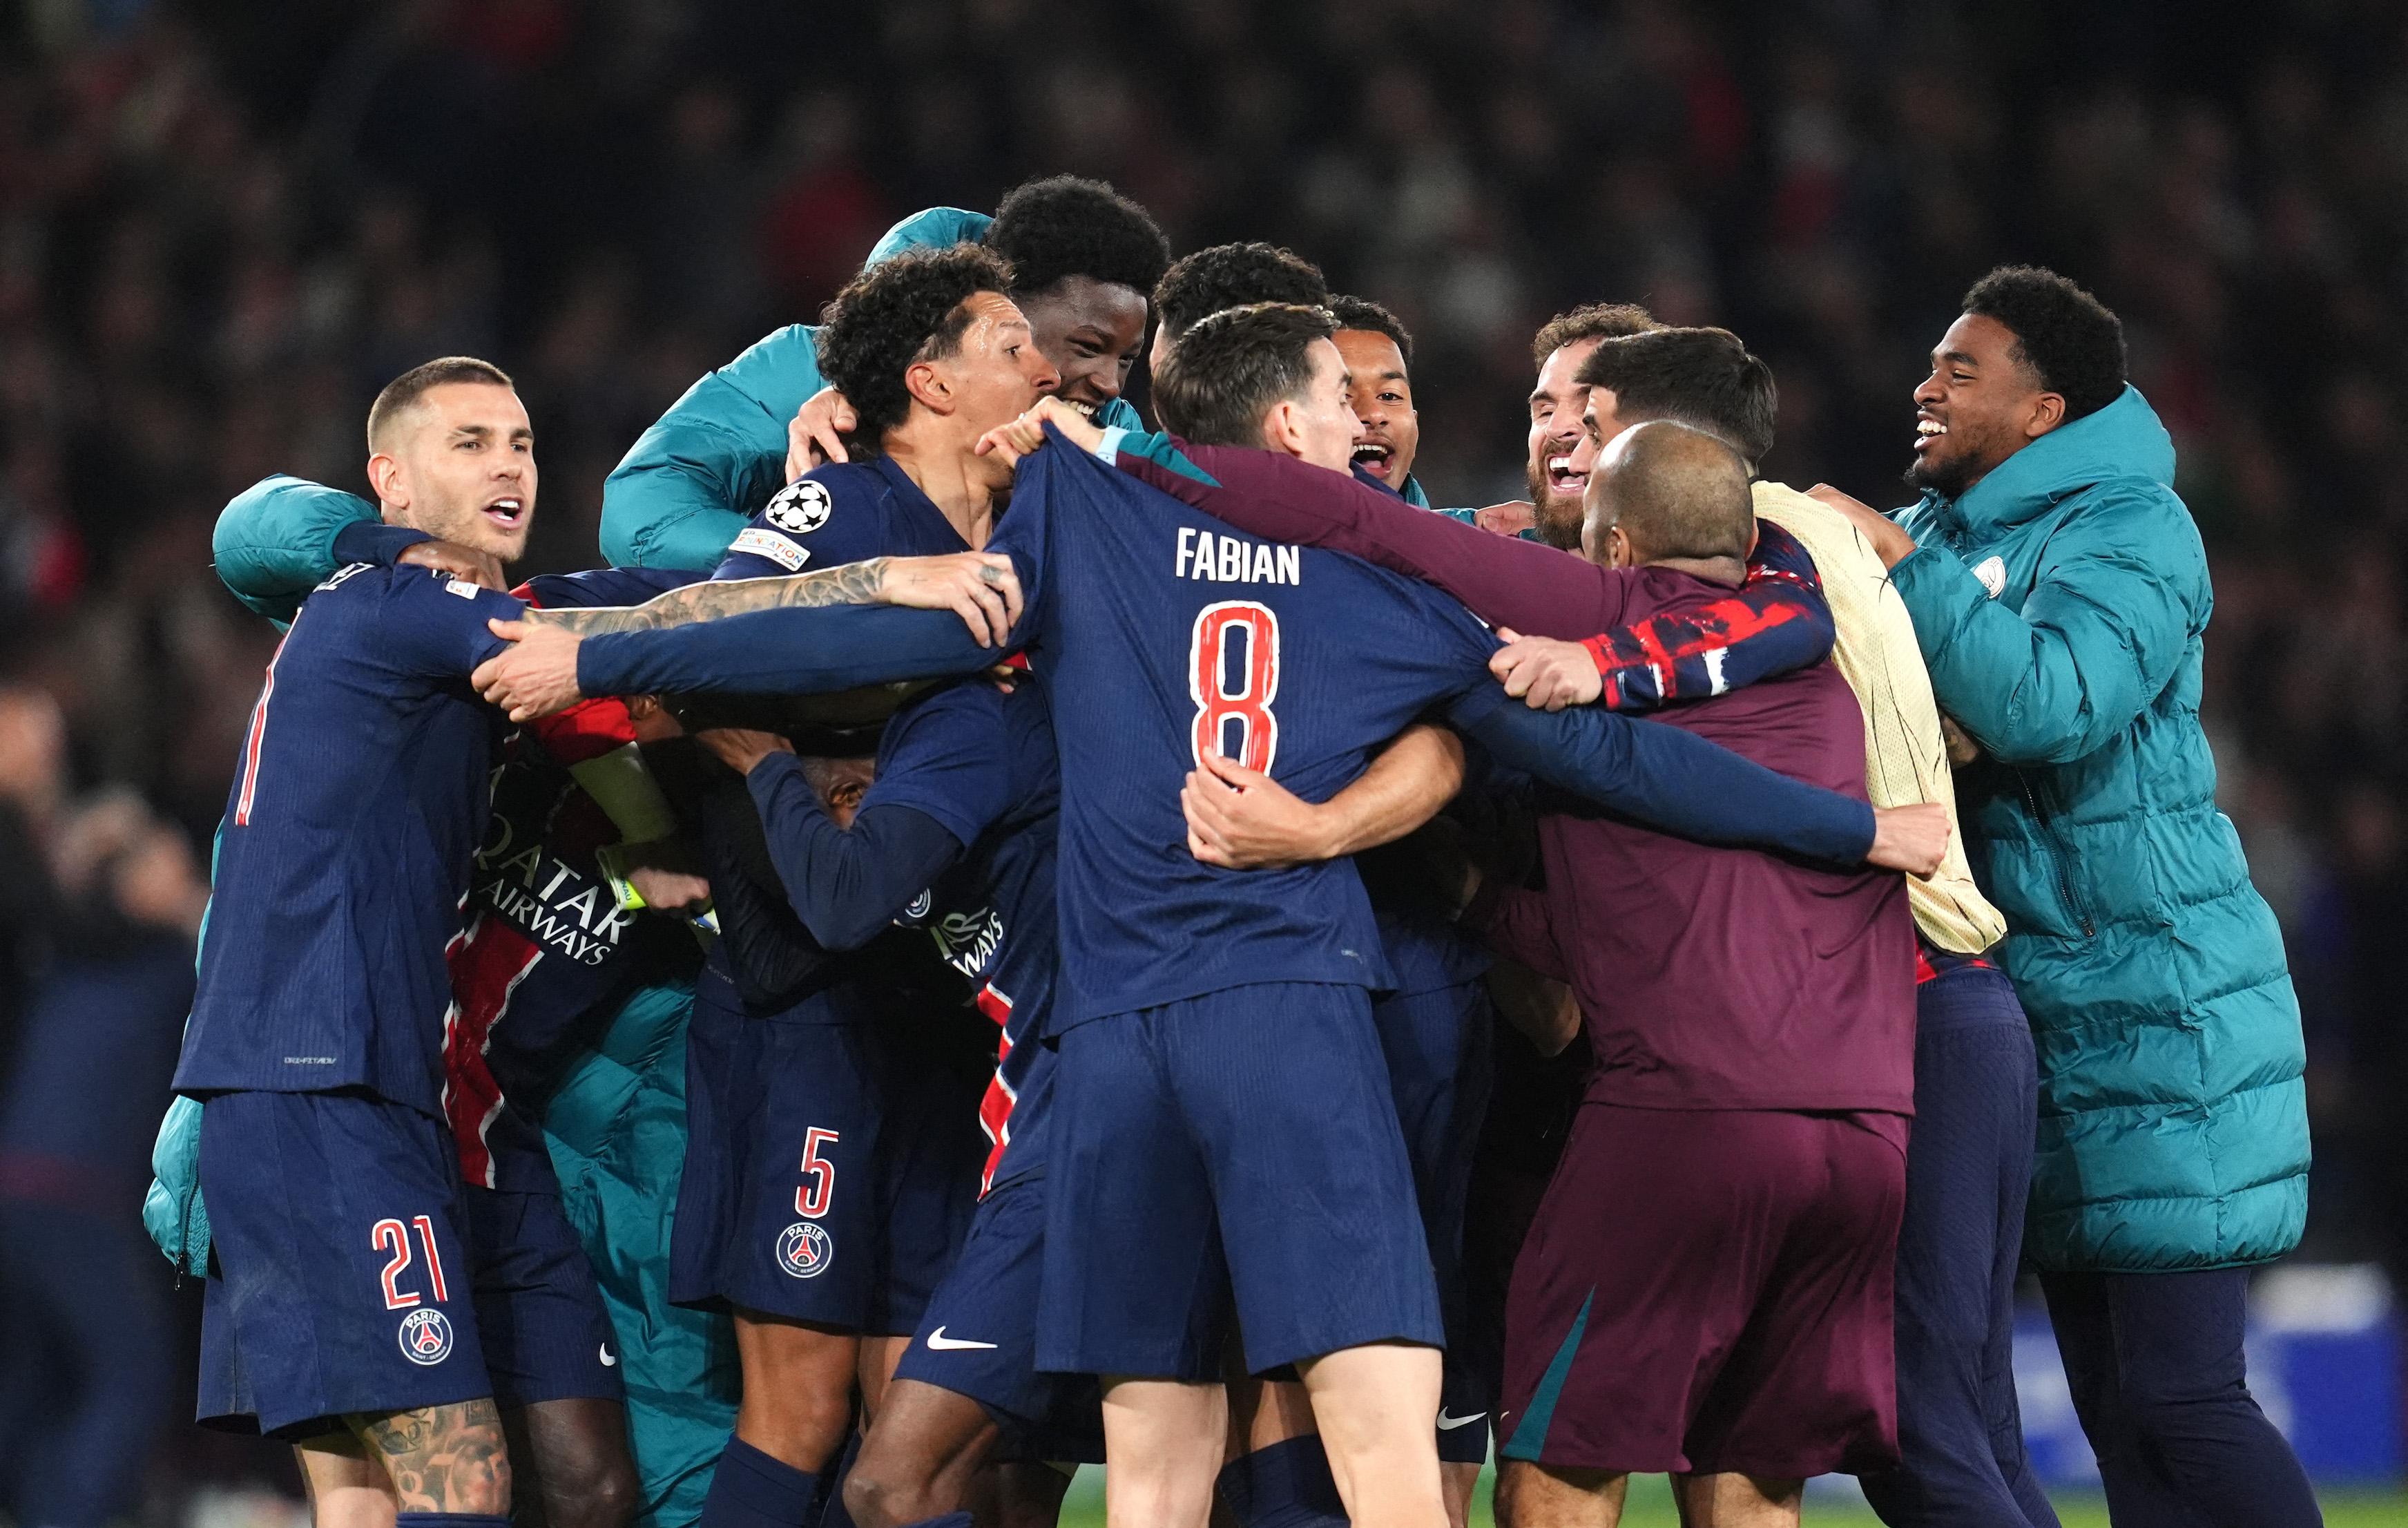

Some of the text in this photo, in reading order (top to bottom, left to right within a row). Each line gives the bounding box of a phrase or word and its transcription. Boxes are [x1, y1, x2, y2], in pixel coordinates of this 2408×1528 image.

[1175, 527, 1300, 586] FABIAN
[1189, 600, 1280, 778] 8
[477, 878, 611, 966] AIRWAYS
[795, 1125, 839, 1219] 5
[372, 1215, 448, 1310] 21
[787, 1225, 825, 1241] PARIS
[406, 1312, 441, 1328] PARIS
